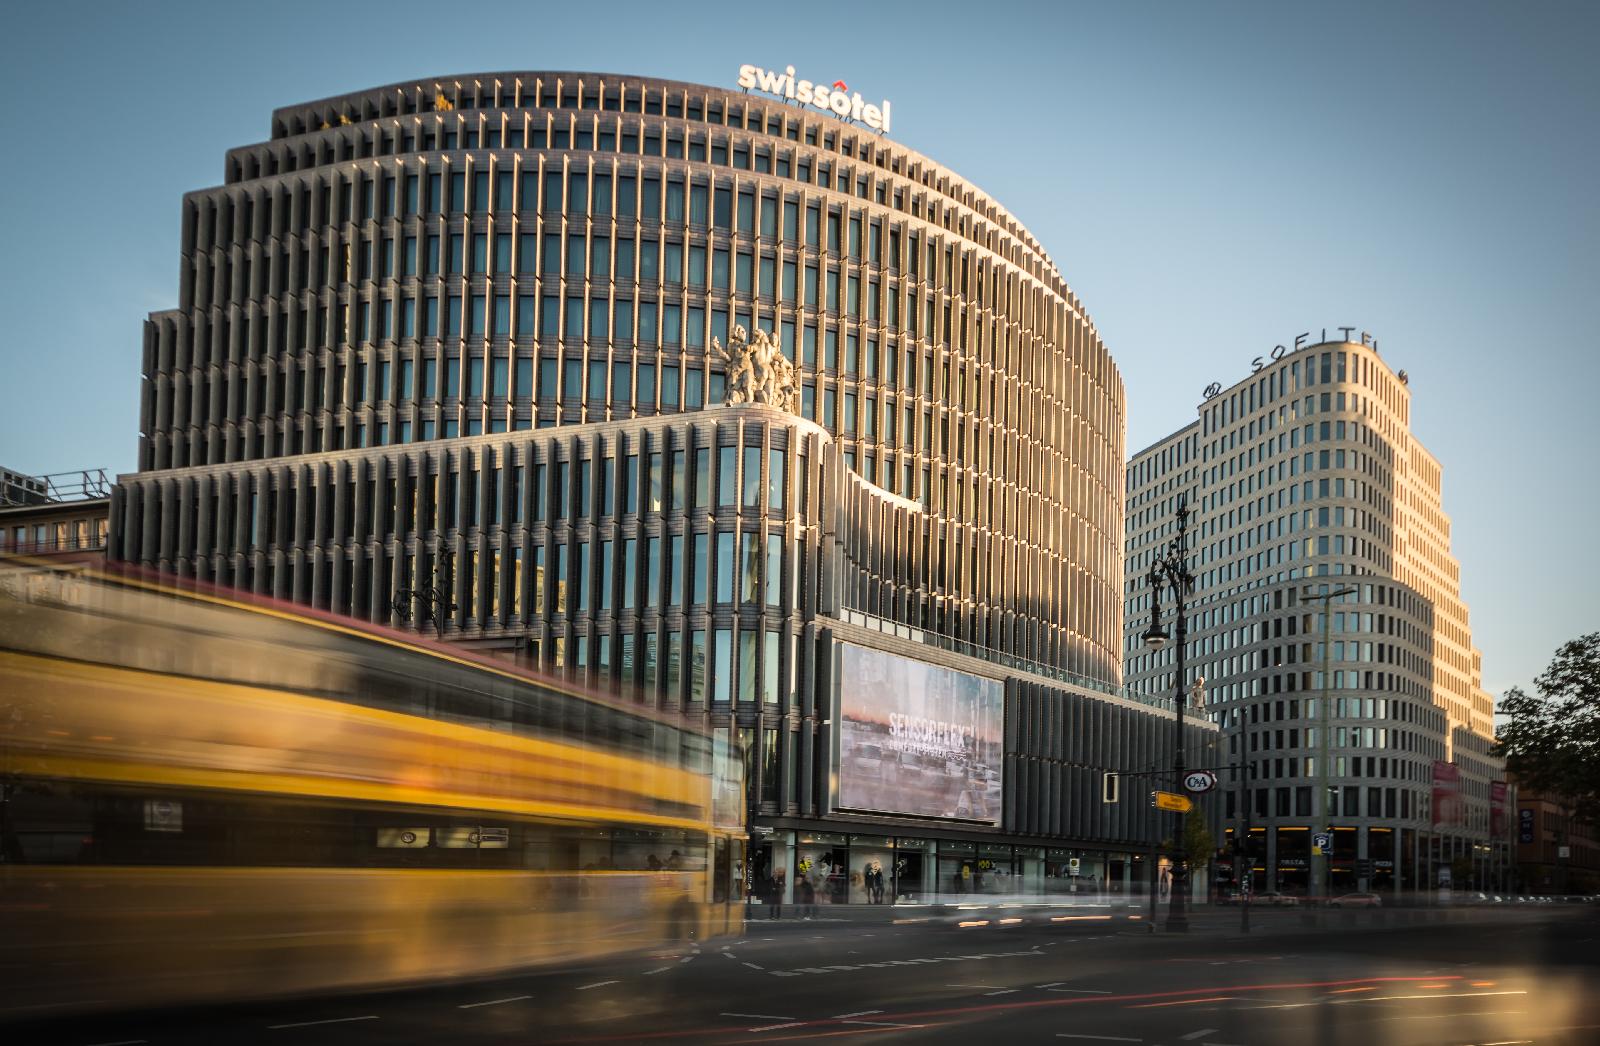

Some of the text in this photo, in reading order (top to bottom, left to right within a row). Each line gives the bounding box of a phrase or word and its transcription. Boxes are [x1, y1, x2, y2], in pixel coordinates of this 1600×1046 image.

[738, 64, 890, 133] swissôtel
[1187, 776, 1207, 787] C&A
[1317, 839, 1326, 848] P
